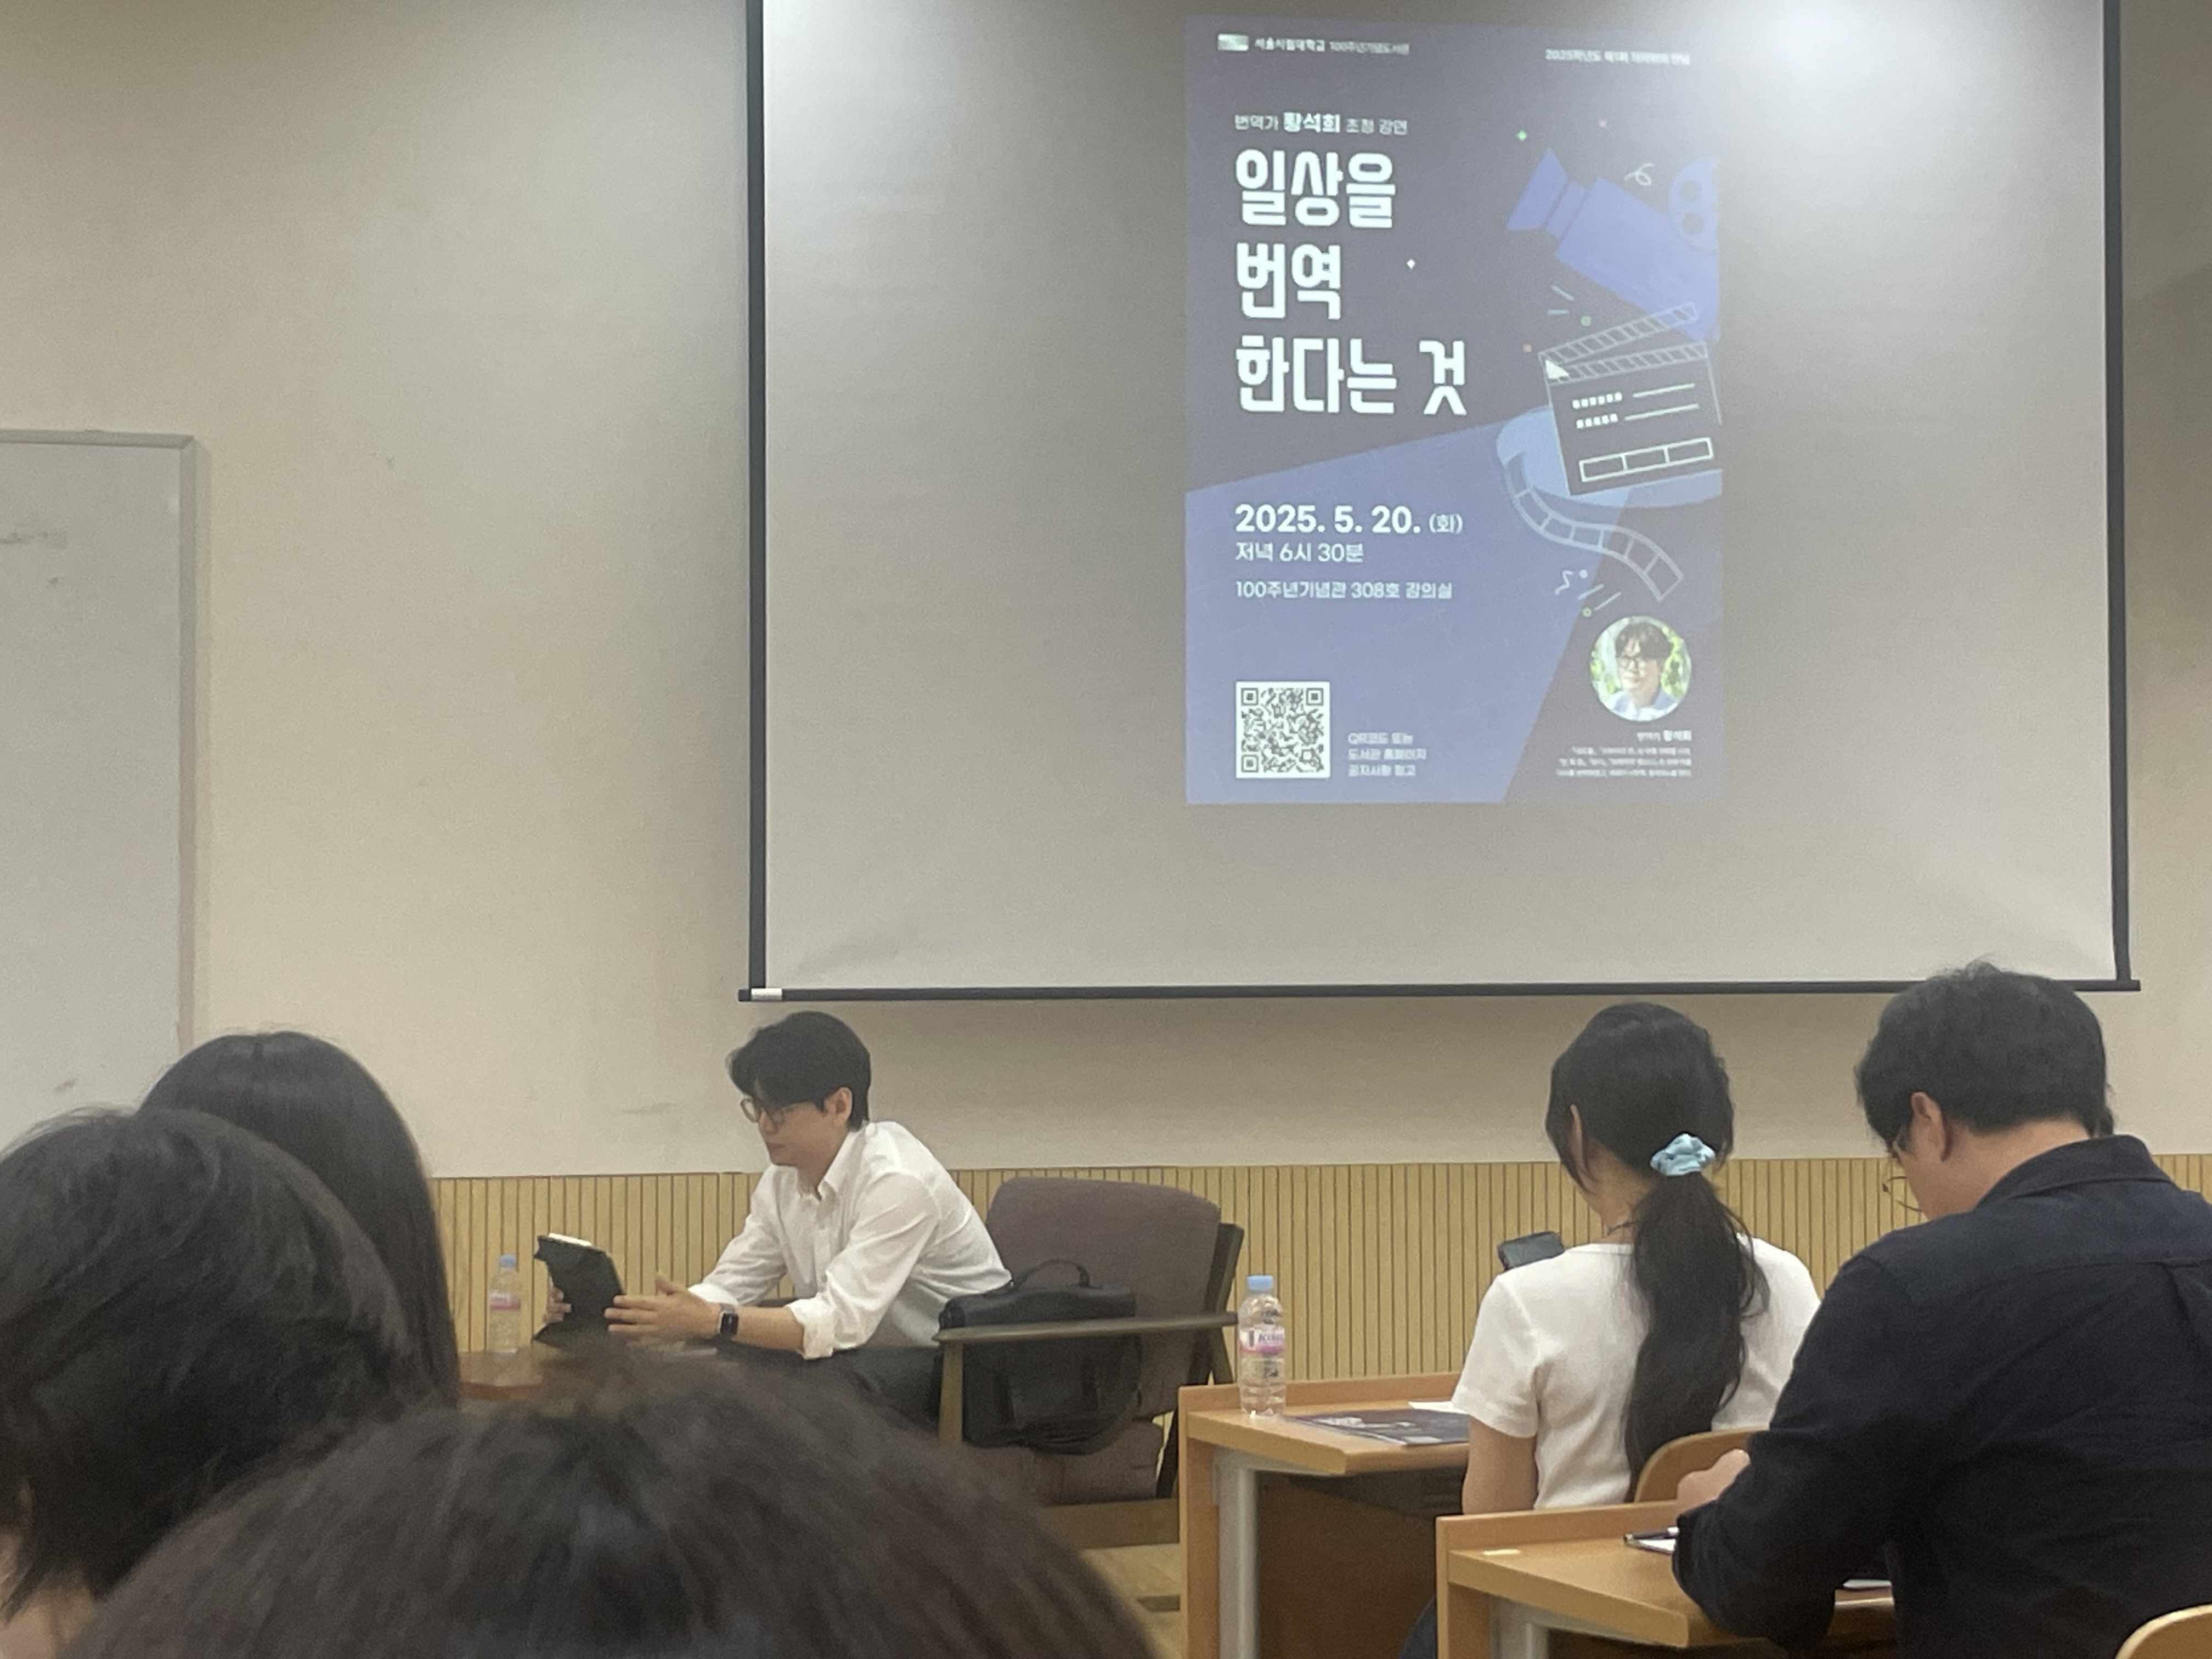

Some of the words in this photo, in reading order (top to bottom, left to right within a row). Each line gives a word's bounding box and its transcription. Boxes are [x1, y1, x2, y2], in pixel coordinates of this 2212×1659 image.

[1235, 115, 1279, 131] 번역가
[1284, 112, 1340, 133] 황석희
[1379, 119, 1407, 136] 강연
[1236, 149, 1396, 228] 일상을
[1237, 242, 1341, 320] 번역
[1235, 335, 1397, 414] 한다는
[1419, 340, 1466, 415] 것
[1235, 504, 1325, 533] 2025.
[1334, 505, 1362, 533] 5.
[1372, 505, 1421, 534] 20.
[1429, 514, 1463, 534] (화)
[1235, 542, 1273, 561] 저녁
[1279, 543, 1311, 562] 6시
[1318, 543, 1363, 562] 30분
[1236, 581, 1346, 599] 100주년기념관
[1351, 582, 1400, 599] 308호
[1406, 582, 1452, 599] 강의실
